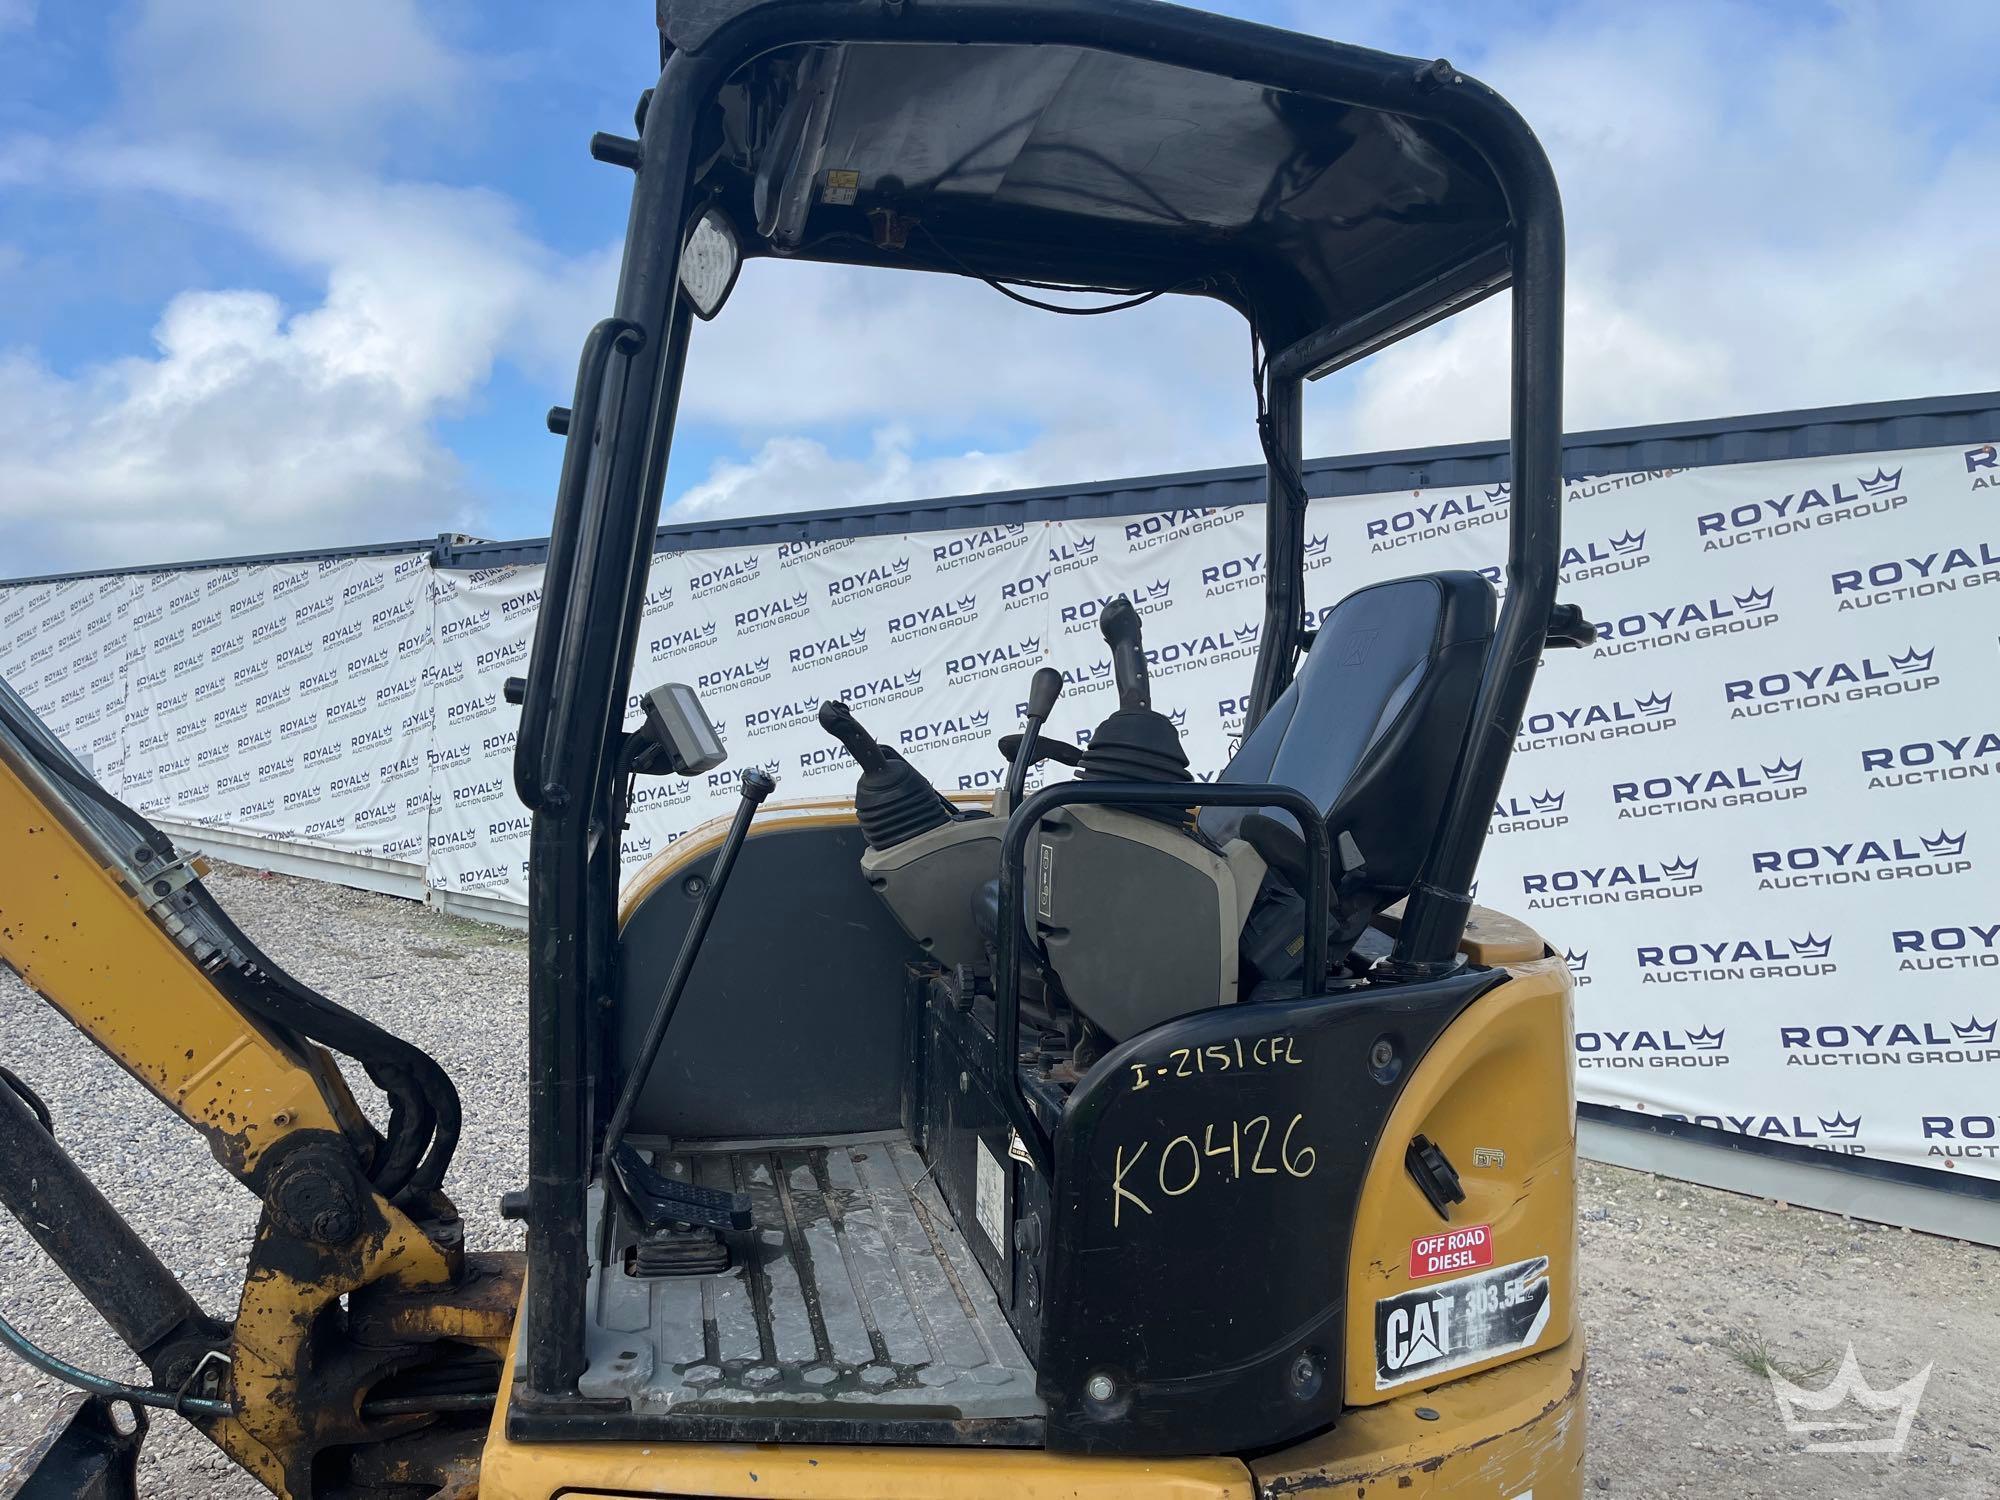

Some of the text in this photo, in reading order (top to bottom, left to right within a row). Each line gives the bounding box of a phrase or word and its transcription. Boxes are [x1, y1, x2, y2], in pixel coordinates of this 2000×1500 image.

[1367, 494, 1485, 539] ROYAL
[1697, 482, 1858, 536] ROYAL
[1128, 510, 1245, 554] AUCTION GROUP
[1371, 509, 1508, 554] AUCTION GROU
[1703, 496, 1908, 552] AUCTION GROUP
[933, 528, 1006, 562] ROYAL
[936, 536, 1028, 574] AUCTION GROUP
[780, 548, 821, 570] AUCTION
[1054, 556, 1098, 576] GROUP
[1202, 554, 1262, 584] ROY
[1575, 555, 1650, 582] GROUP
[1832, 543, 2000, 594] ROYAL
[272, 575, 300, 594] ROYAL
[690, 563, 744, 591] ROYAL
[692, 572, 760, 600] AUCTION GROUP
[829, 565, 892, 597] ROYAL
[342, 578, 375, 599] ROYAL
[831, 576, 912, 607] AUCTION GROUP
[1838, 578, 1956, 612] AUCTION
[170, 593, 192, 610] ROYAL
[502, 590, 542, 614] ROYAL
[647, 602, 674, 617] GROUP
[1004, 592, 1049, 612] AUCTIO
[372, 604, 405, 624] ROYAL
[504, 606, 532, 622] AUCTION
[734, 599, 793, 628] ROYAL
[736, 608, 810, 637] AUCTION GROUP
[888, 602, 957, 634] ROYAL
[322, 626, 354, 646] ROYAL
[441, 614, 479, 636] ROYAL
[442, 622, 490, 644] AUCTION GROUP
[890, 613, 978, 645] AUCTION GROUP
[154, 634, 178, 648] ROYAL
[650, 628, 702, 654] ROYAL
[1592, 614, 1779, 659] AUCTION GROUP
[276, 646, 306, 664] ROYAL
[476, 644, 516, 666] ROYAL
[652, 637, 718, 664] AUCTION GROUP
[790, 635, 850, 663] ROYAL
[792, 646, 868, 674] AUCTION GROUP
[348, 652, 380, 672] ROYAL
[478, 653, 528, 675] AUCTION GROUP
[946, 645, 1020, 676] ROYAL
[948, 656, 1043, 686] AUCTION GROUP
[1148, 658, 1208, 680] AUCTION
[300, 672, 330, 691] ROYAL
[698, 664, 754, 689] ROYAL
[700, 674, 772, 698] AUCTION GROUP
[1725, 658, 1889, 703] ROYAL
[376, 680, 409, 700] ROYAL
[840, 676, 904, 703] ROYAL
[888, 687, 924, 702] GROUP
[1068, 680, 1114, 698] GROUP
[1730, 676, 1940, 720] AUCTION GROUP
[157, 698, 181, 712] ROYAL
[448, 697, 484, 718] ROYAL
[746, 702, 802, 728] ROYAL
[449, 707, 496, 726] AUCTION GROUP
[352, 730, 384, 748] ROYAL
[747, 722, 787, 738] AUCTION
[900, 717, 970, 744] ROYAL
[1600, 718, 1677, 740] GROUP
[484, 731, 516, 750] ROYA
[902, 729, 992, 756] AUCTION GROUP
[304, 746, 333, 762] ROYAL
[484, 746, 510, 758] AUCTION
[800, 745, 851, 767] ROYA
[1862, 733, 2000, 772] ROYA
[802, 762, 845, 778] AUCTION
[1868, 764, 1988, 789] AUCTION
[454, 783, 493, 800] ROYAL
[710, 785, 741, 797] AUCTIO
[1612, 767, 1761, 803] ROYAL
[284, 789, 312, 804] ROYAL
[456, 792, 504, 808] AUCTION GROUP
[664, 796, 690, 808] GROUP
[1618, 787, 1808, 820] AUCTION GROUP
[354, 805, 388, 823] ROYAL
[1498, 816, 1568, 834] GROUP
[490, 817, 530, 836] ROYAL
[429, 830, 466, 848] ROYAL
[456, 842, 476, 850] GROUP
[490, 832, 518, 844] AUCTION
[1752, 838, 1920, 873] ROYAL
[460, 867, 498, 884] ROYAL
[461, 878, 509, 892] AUCTION GROUP
[1524, 864, 1660, 894] ROYAL
[1758, 861, 1972, 890] AUCTION GROUP
[1527, 884, 1702, 910] AUCTION GROUP
[1892, 924, 2000, 953] ROY
[1638, 940, 1789, 967] ROYAL
[1899, 954, 2000, 971] AUCTIO
[1642, 963, 1837, 984] AUCTION GROUP
[1576, 1028, 1686, 1052] OYAL
[1780, 1023, 1950, 1048] ROYAL
[1578, 1054, 1730, 1069] CTION GROUP
[1786, 1050, 2000, 1066] AUCTION GROUP
[1927, 1145, 2000, 1158] AUCT
[1416, 1230, 1486, 1256] OFF ROAD
[1428, 1250, 1476, 1272] DIESEL
[1386, 1296, 1454, 1370] CAT
